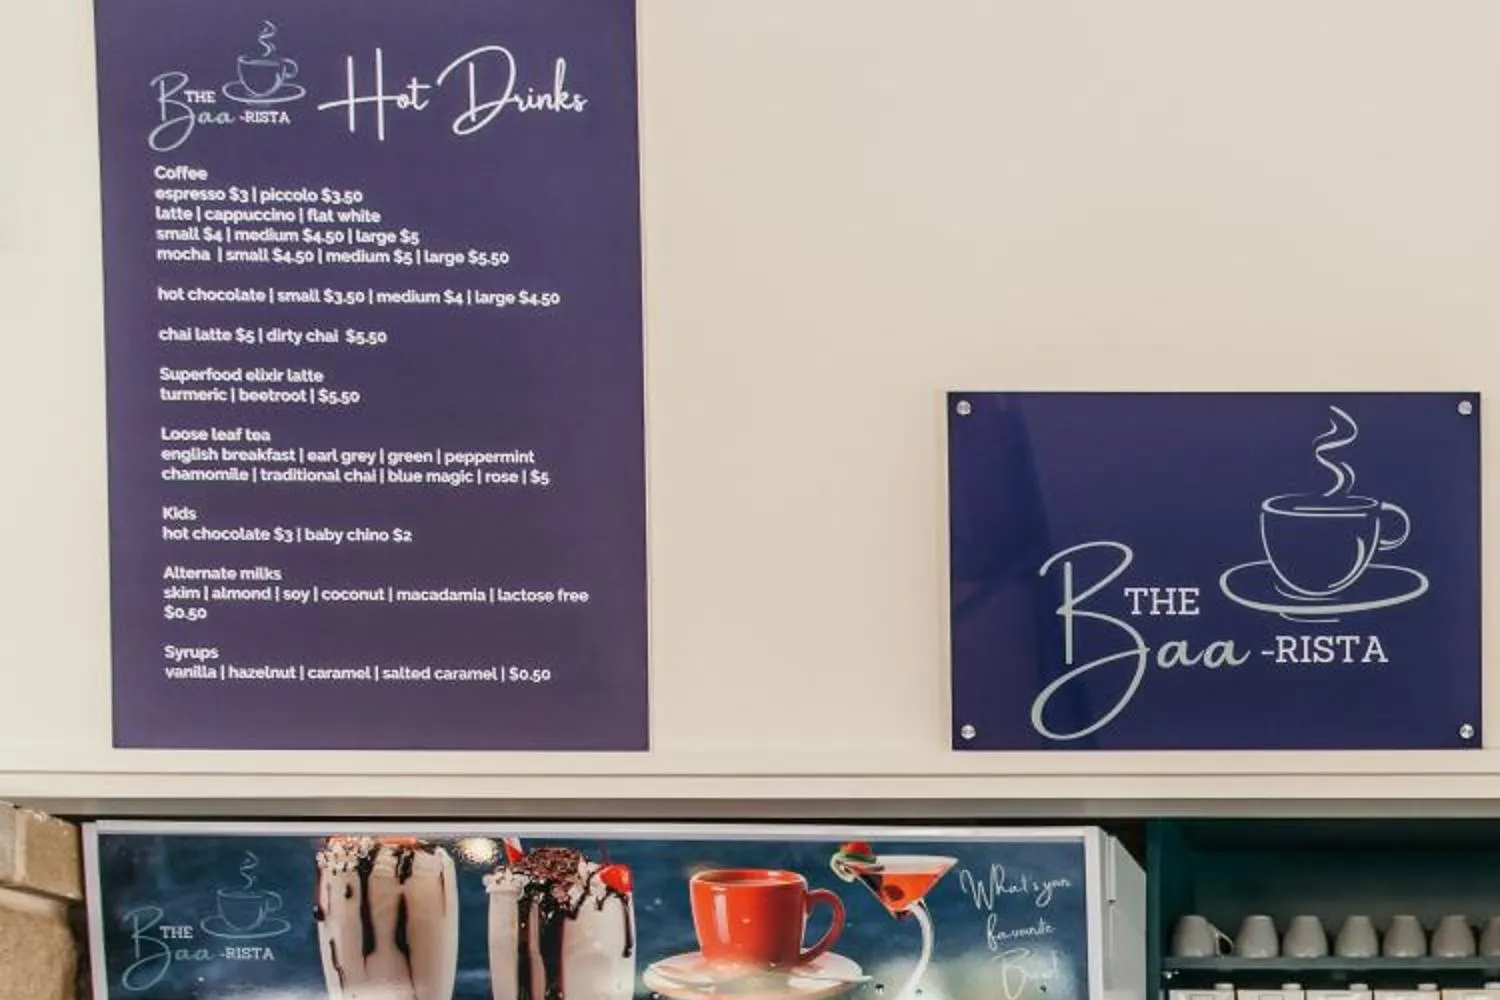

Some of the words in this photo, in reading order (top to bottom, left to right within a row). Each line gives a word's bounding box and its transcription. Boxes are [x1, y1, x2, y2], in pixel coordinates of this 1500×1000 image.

[184, 90, 216, 104] THE
[317, 47, 431, 141] Hot
[437, 45, 589, 136] Drinks
[152, 165, 209, 181] Coffee
[154, 188, 227, 203] espresso
[228, 186, 249, 203] $3
[259, 187, 319, 205] piccolo
[320, 187, 364, 205] $3.50
[155, 205, 194, 220] latte
[203, 207, 297, 224] cappuccino
[306, 208, 335, 222] flat
[336, 208, 382, 223] white
[156, 246, 212, 261] mocha
[225, 247, 270, 262] small
[271, 247, 315, 265] $4.50
[325, 249, 391, 263] medium
[393, 248, 414, 266] $5
[423, 249, 466, 267] large
[467, 248, 510, 267] $5.50
[157, 286, 186, 301] hot
[186, 287, 267, 302] chocolate
[276, 288, 322, 303] small
[323, 288, 366, 305] $3.50
[375, 289, 441, 304] medium
[443, 289, 465, 306] $4
[474, 289, 517, 308] large
[518, 289, 561, 307] $4.50
[157, 326, 193, 341] chai
[194, 327, 233, 342] latte
[234, 327, 256, 344] $5
[265, 327, 303, 346] dirty
[305, 328, 339, 343] chai
[345, 328, 388, 345] $5.50
[159, 367, 243, 384] Superfood
[244, 368, 285, 382] elixir
[286, 368, 325, 383] latte
[159, 387, 229, 401] turmeric
[238, 387, 308, 403] beetroot
[317, 387, 361, 405] $5.50
[160, 426, 209, 441] Loose
[210, 427, 243, 441] leaf
[244, 428, 272, 442] tea
[160, 447, 219, 464] english
[221, 447, 297, 462] breakfast
[306, 448, 339, 462] earl
[339, 451, 377, 466] grey
[386, 451, 434, 466] green
[443, 449, 536, 467] peppermint
[161, 466, 250, 481] chamomile
[259, 467, 342, 482] traditional
[343, 468, 377, 483] chai
[387, 468, 424, 483] blue
[425, 469, 474, 487] magic
[484, 472, 519, 483] rose
[529, 468, 551, 486] $5
[161, 506, 199, 521] Kids
[162, 565, 238, 580] Alternate
[239, 566, 283, 581] milks
[163, 585, 201, 600] skim
[211, 586, 272, 600] almond
[282, 589, 311, 604] soy
[320, 587, 386, 601] coconut
[395, 587, 487, 602] macadamia
[497, 588, 555, 603] lactose
[557, 588, 590, 603] free
[1123, 587, 1200, 615] THE
[163, 604, 209, 621] $0.50
[1031, 541, 1250, 740] Baa
[163, 644, 220, 662] Syrups
[163, 664, 219, 679] vanilla
[227, 664, 298, 679] hazelnut
[306, 665, 373, 680] caramel
[381, 666, 432, 680] salted
[432, 666, 500, 681] caramel
[507, 665, 552, 683] $0.50
[159, 925, 194, 939] THE
